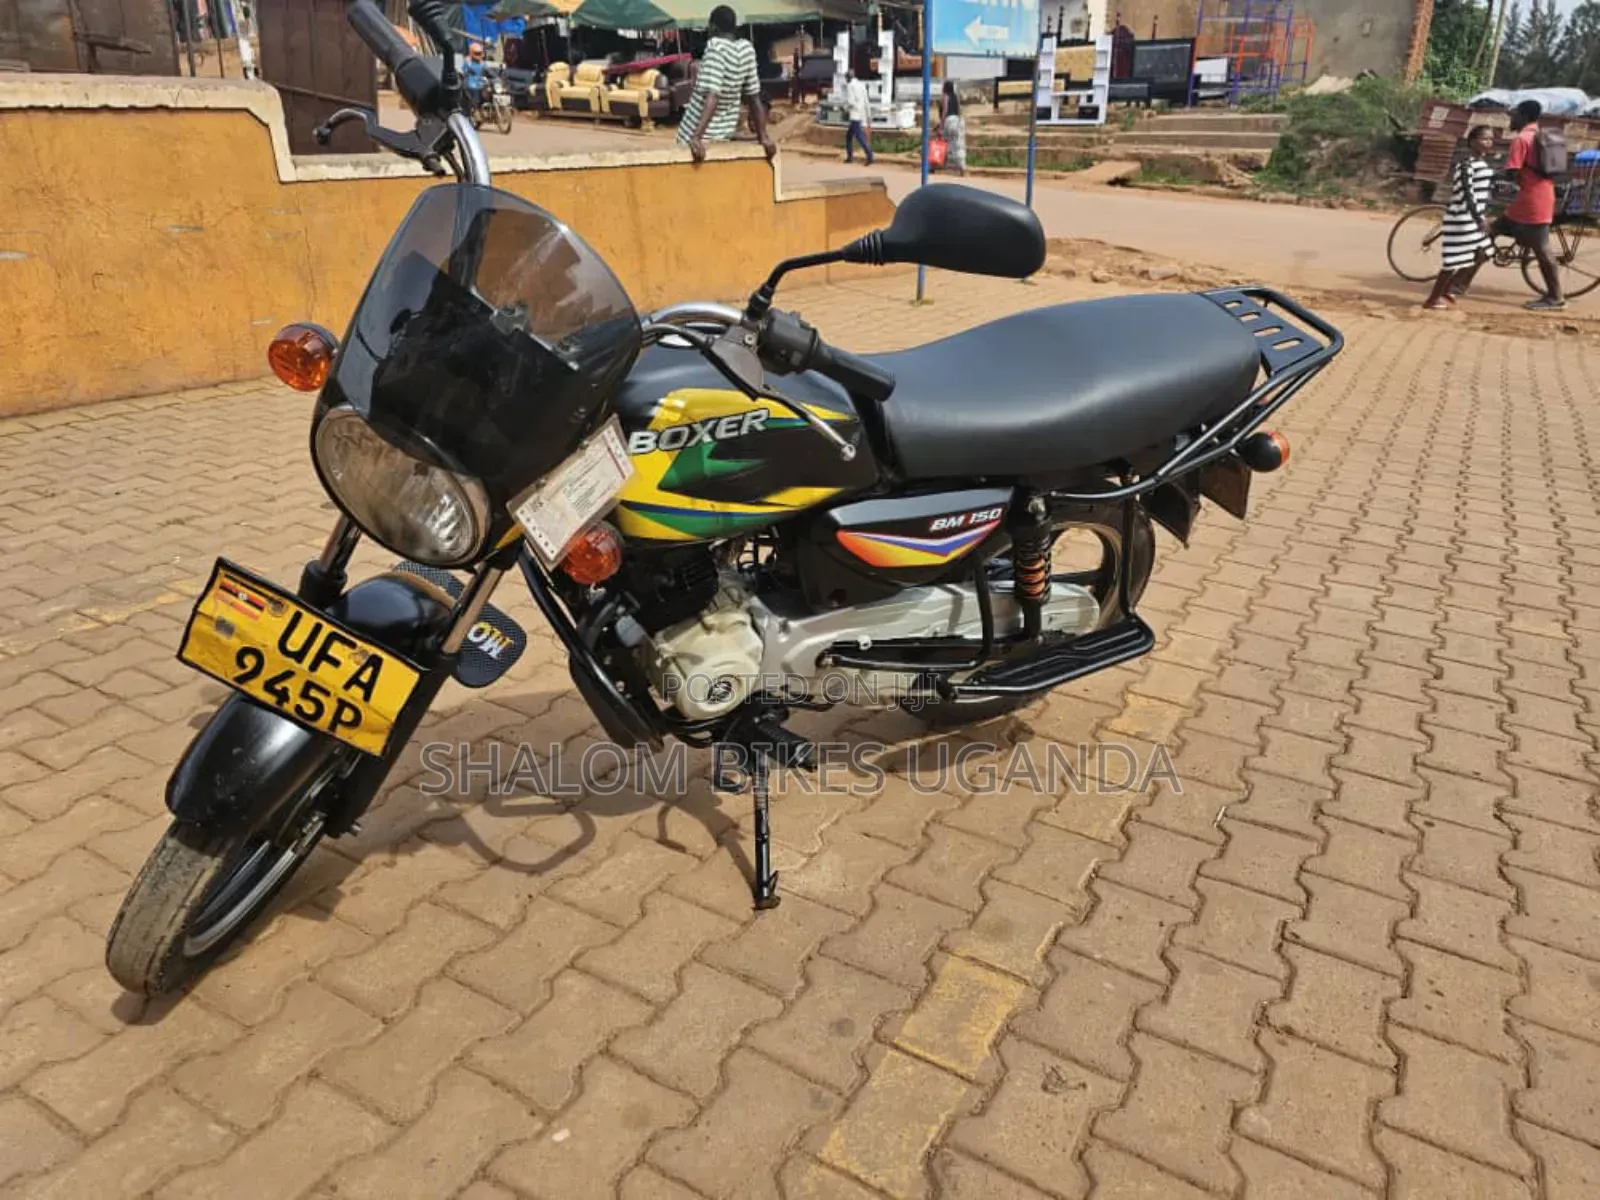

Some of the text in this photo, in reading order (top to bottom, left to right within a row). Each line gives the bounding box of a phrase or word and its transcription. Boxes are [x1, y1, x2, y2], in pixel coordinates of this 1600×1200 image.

[628, 408, 769, 453] BOXER
[929, 508, 1003, 532] BM 150
[232, 645, 363, 733] 945P
[277, 610, 384, 703] UFA
